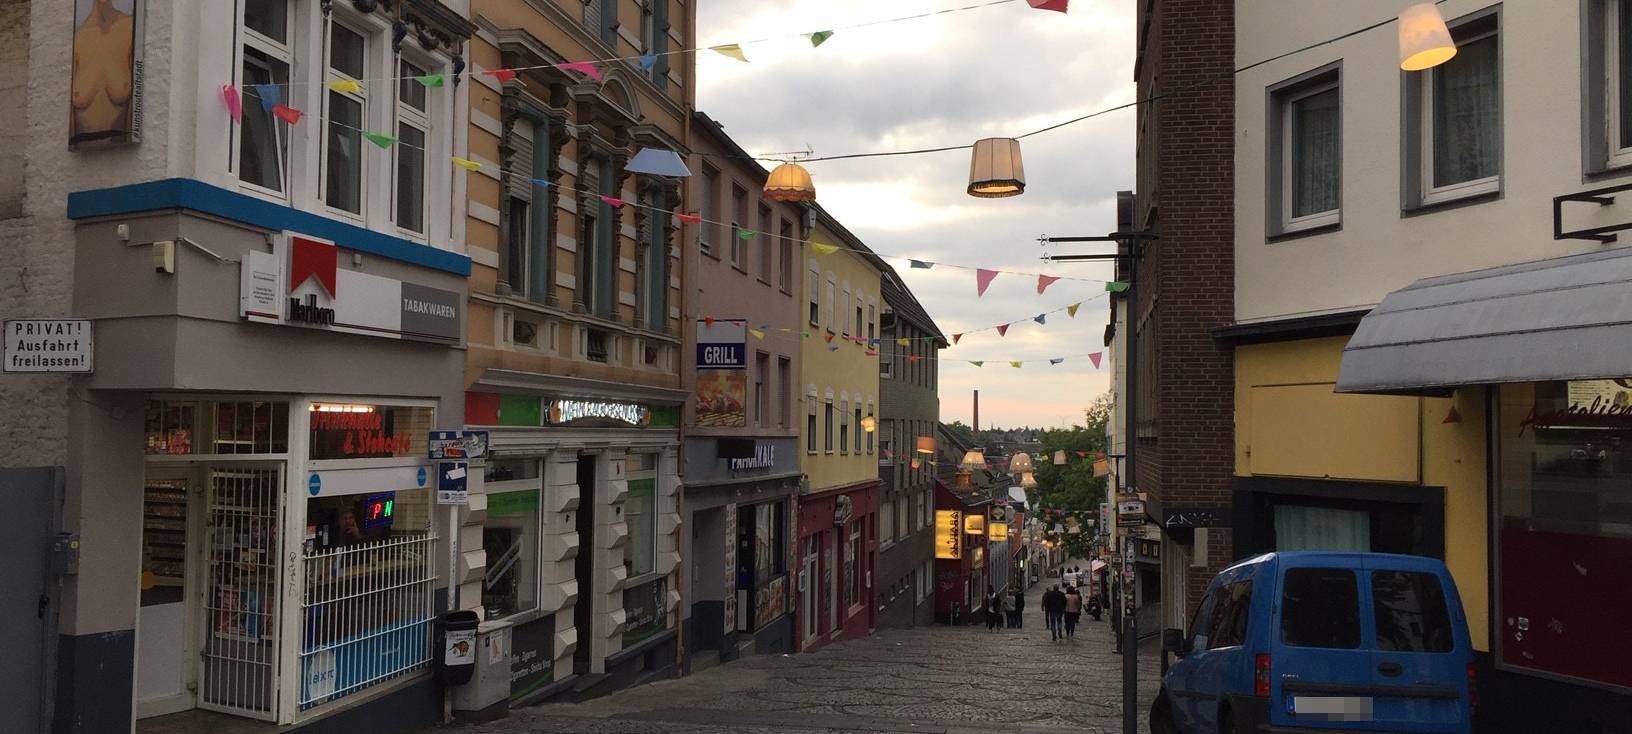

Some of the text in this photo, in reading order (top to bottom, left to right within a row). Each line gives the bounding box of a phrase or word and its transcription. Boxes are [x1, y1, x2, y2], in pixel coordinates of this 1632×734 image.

[289, 294, 335, 324] Marlboro
[403, 298, 456, 318] TABAKWAREN
[16, 323, 81, 335] PRIVAT!
[17, 340, 79, 351] Ausfahrt
[13, 355, 85, 367] freilassen!
[704, 346, 738, 364] GRILL
[343, 431, 354, 454] &
